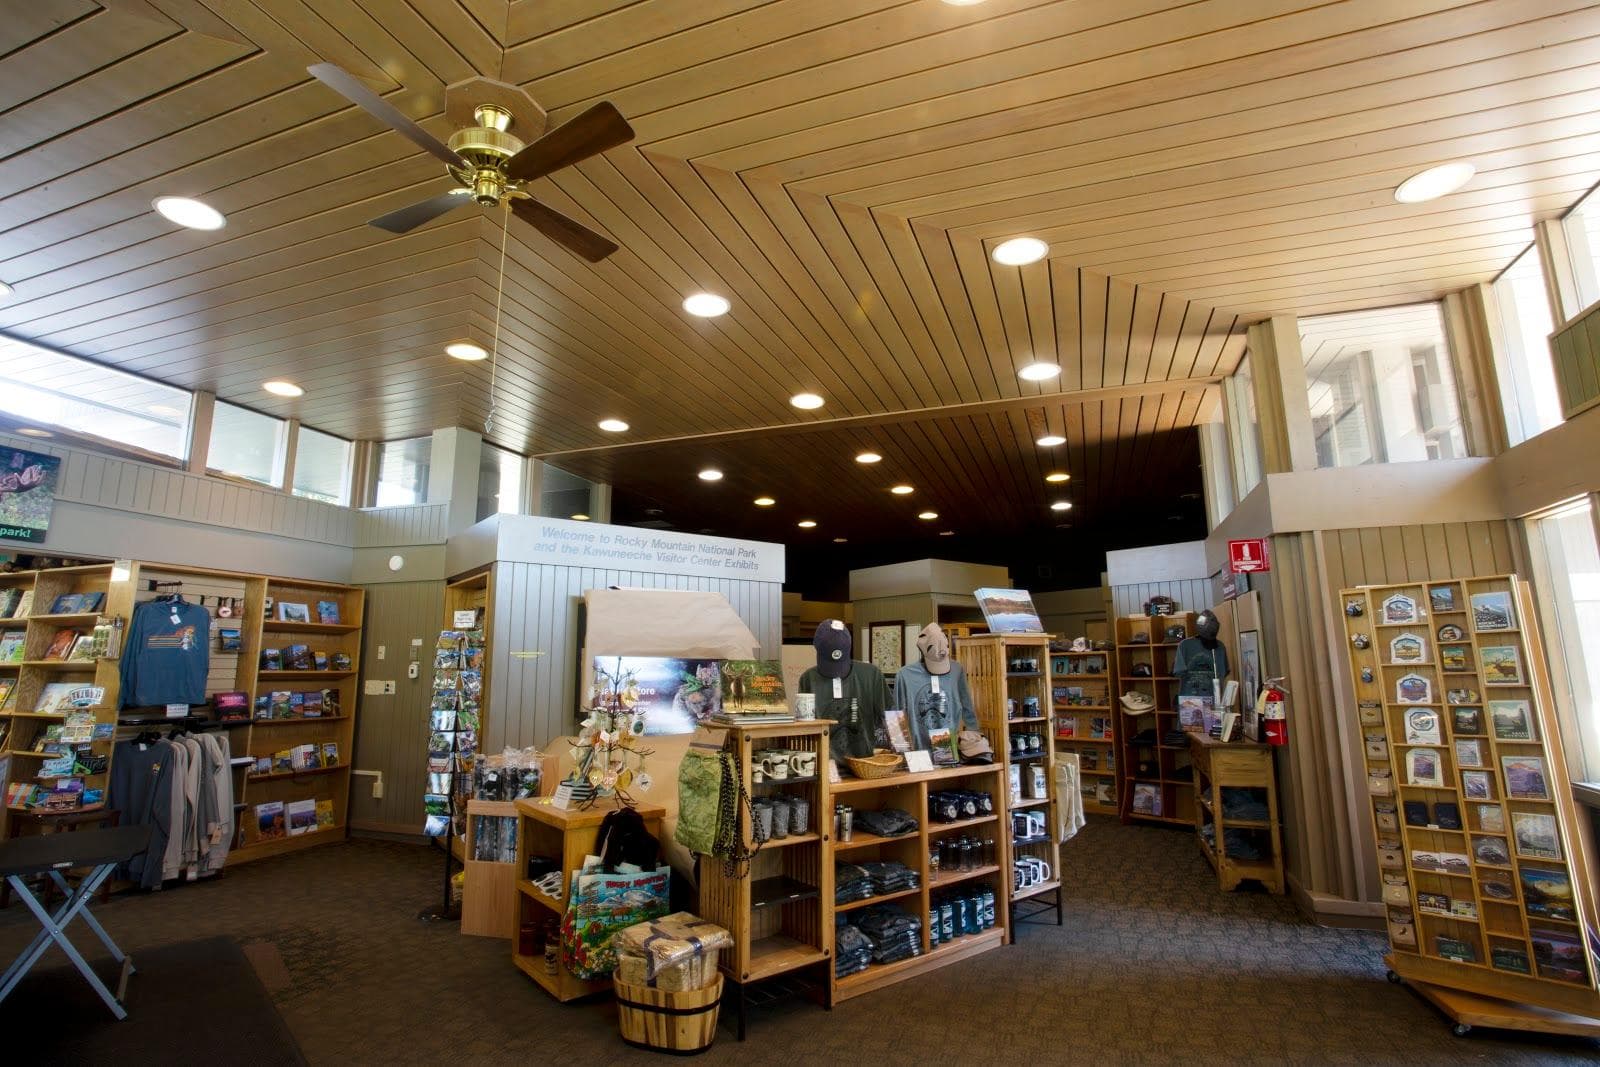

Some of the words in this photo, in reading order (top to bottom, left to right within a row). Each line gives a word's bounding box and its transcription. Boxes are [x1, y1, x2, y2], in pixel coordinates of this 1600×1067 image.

[0, 527, 32, 538] park!
[542, 526, 595, 543] Welcome
[600, 533, 610, 544] to
[614, 535, 648, 549] Rocky
[651, 538, 695, 552] Mountain
[698, 543, 735, 556] National
[737, 547, 757, 559] Park
[533, 542, 556, 552] and
[561, 543, 579, 555] the
[583, 545, 652, 561] Kawuneeche
[657, 551, 687, 564] Visitor
[690, 554, 722, 567] Center
[724, 558, 759, 571] Exhibits
